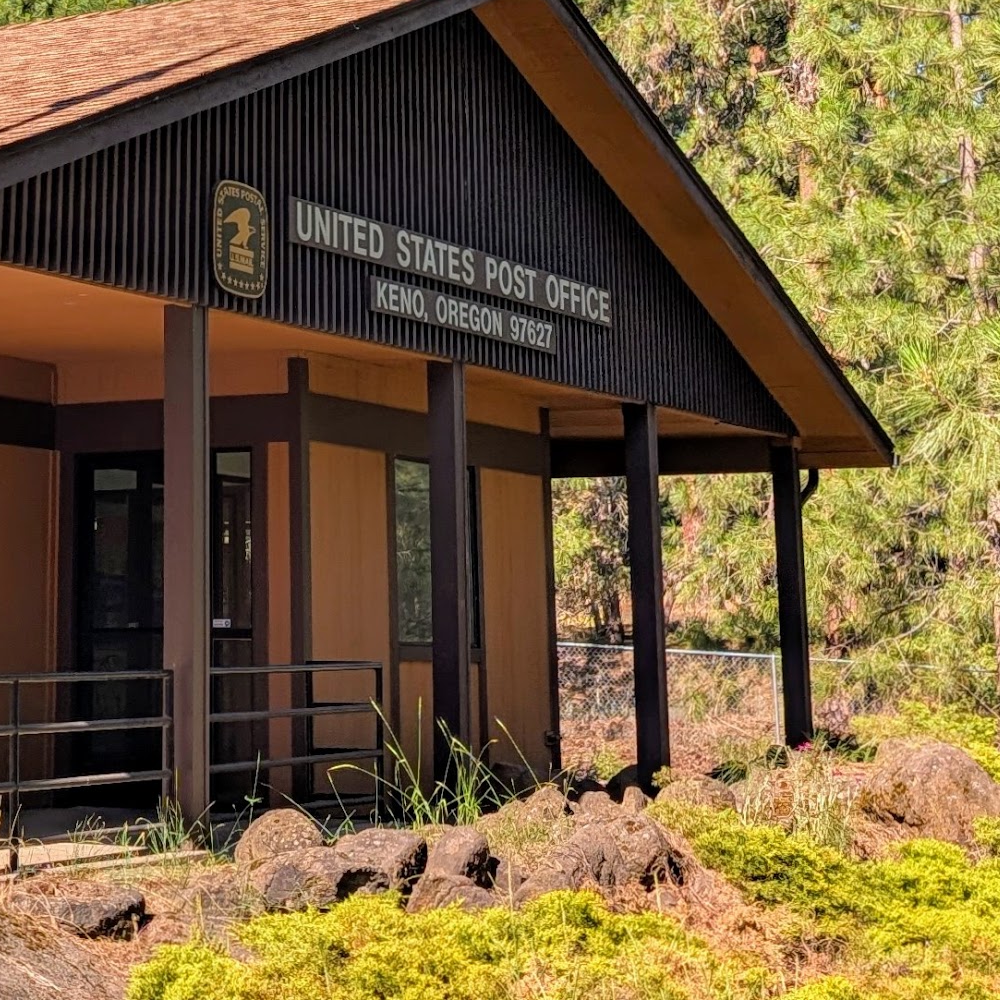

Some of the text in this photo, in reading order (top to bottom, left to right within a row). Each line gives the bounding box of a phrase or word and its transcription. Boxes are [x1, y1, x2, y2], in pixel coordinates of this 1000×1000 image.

[295, 201, 611, 323] UNITED STATES POST OFFICE
[376, 280, 554, 349] KENO, OREGON 97627
